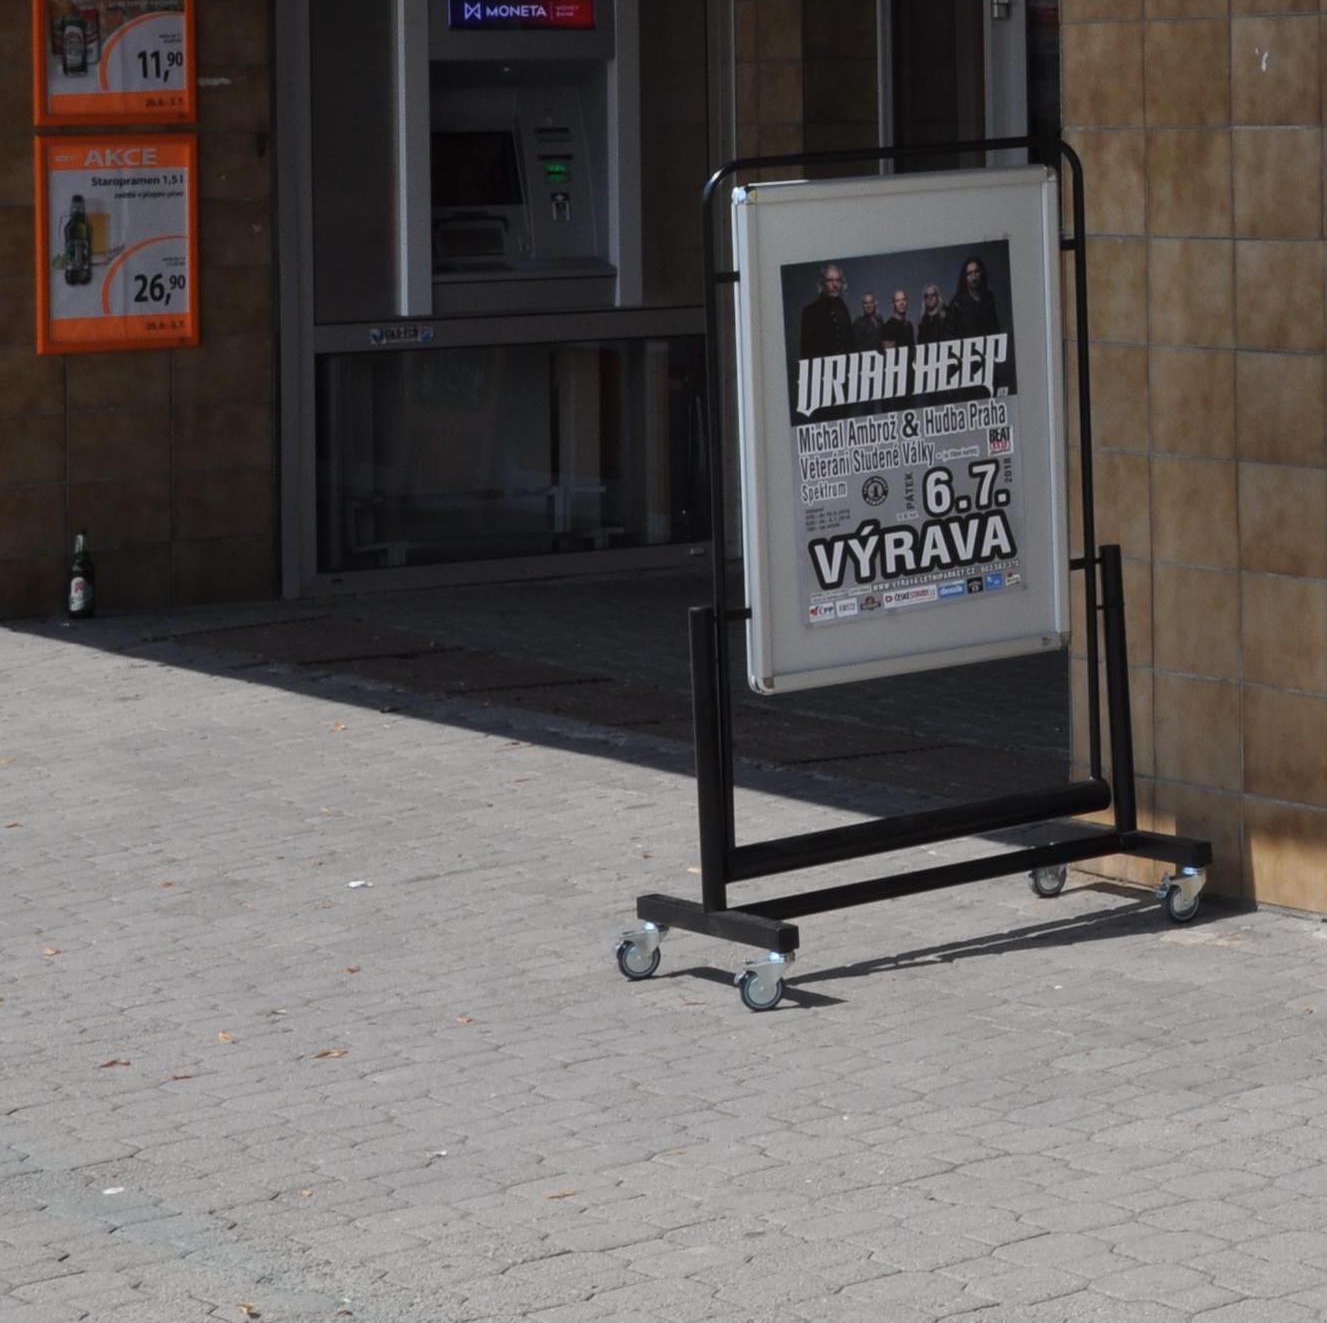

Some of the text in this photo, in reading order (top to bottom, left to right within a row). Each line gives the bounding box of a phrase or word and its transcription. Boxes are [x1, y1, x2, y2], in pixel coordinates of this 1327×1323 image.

[486, 5, 548, 18] MONETA
[138, 50, 183, 82] 11,90
[84, 148, 158, 166] AKCE
[91, 177, 160, 188] Staropramen
[134, 275, 185, 305] 26,90
[797, 333, 1008, 417] URIAH HEEP
[798, 402, 1007, 454] Michal Ambrož & Hudba Praha
[989, 428, 1011, 443] BEAT
[853, 446, 899, 474] Studené
[903, 441, 935, 465] Války
[801, 482, 847, 504] Spektrum
[924, 463, 1010, 515] 6.7.
[811, 512, 1015, 588] VÝRAVA
